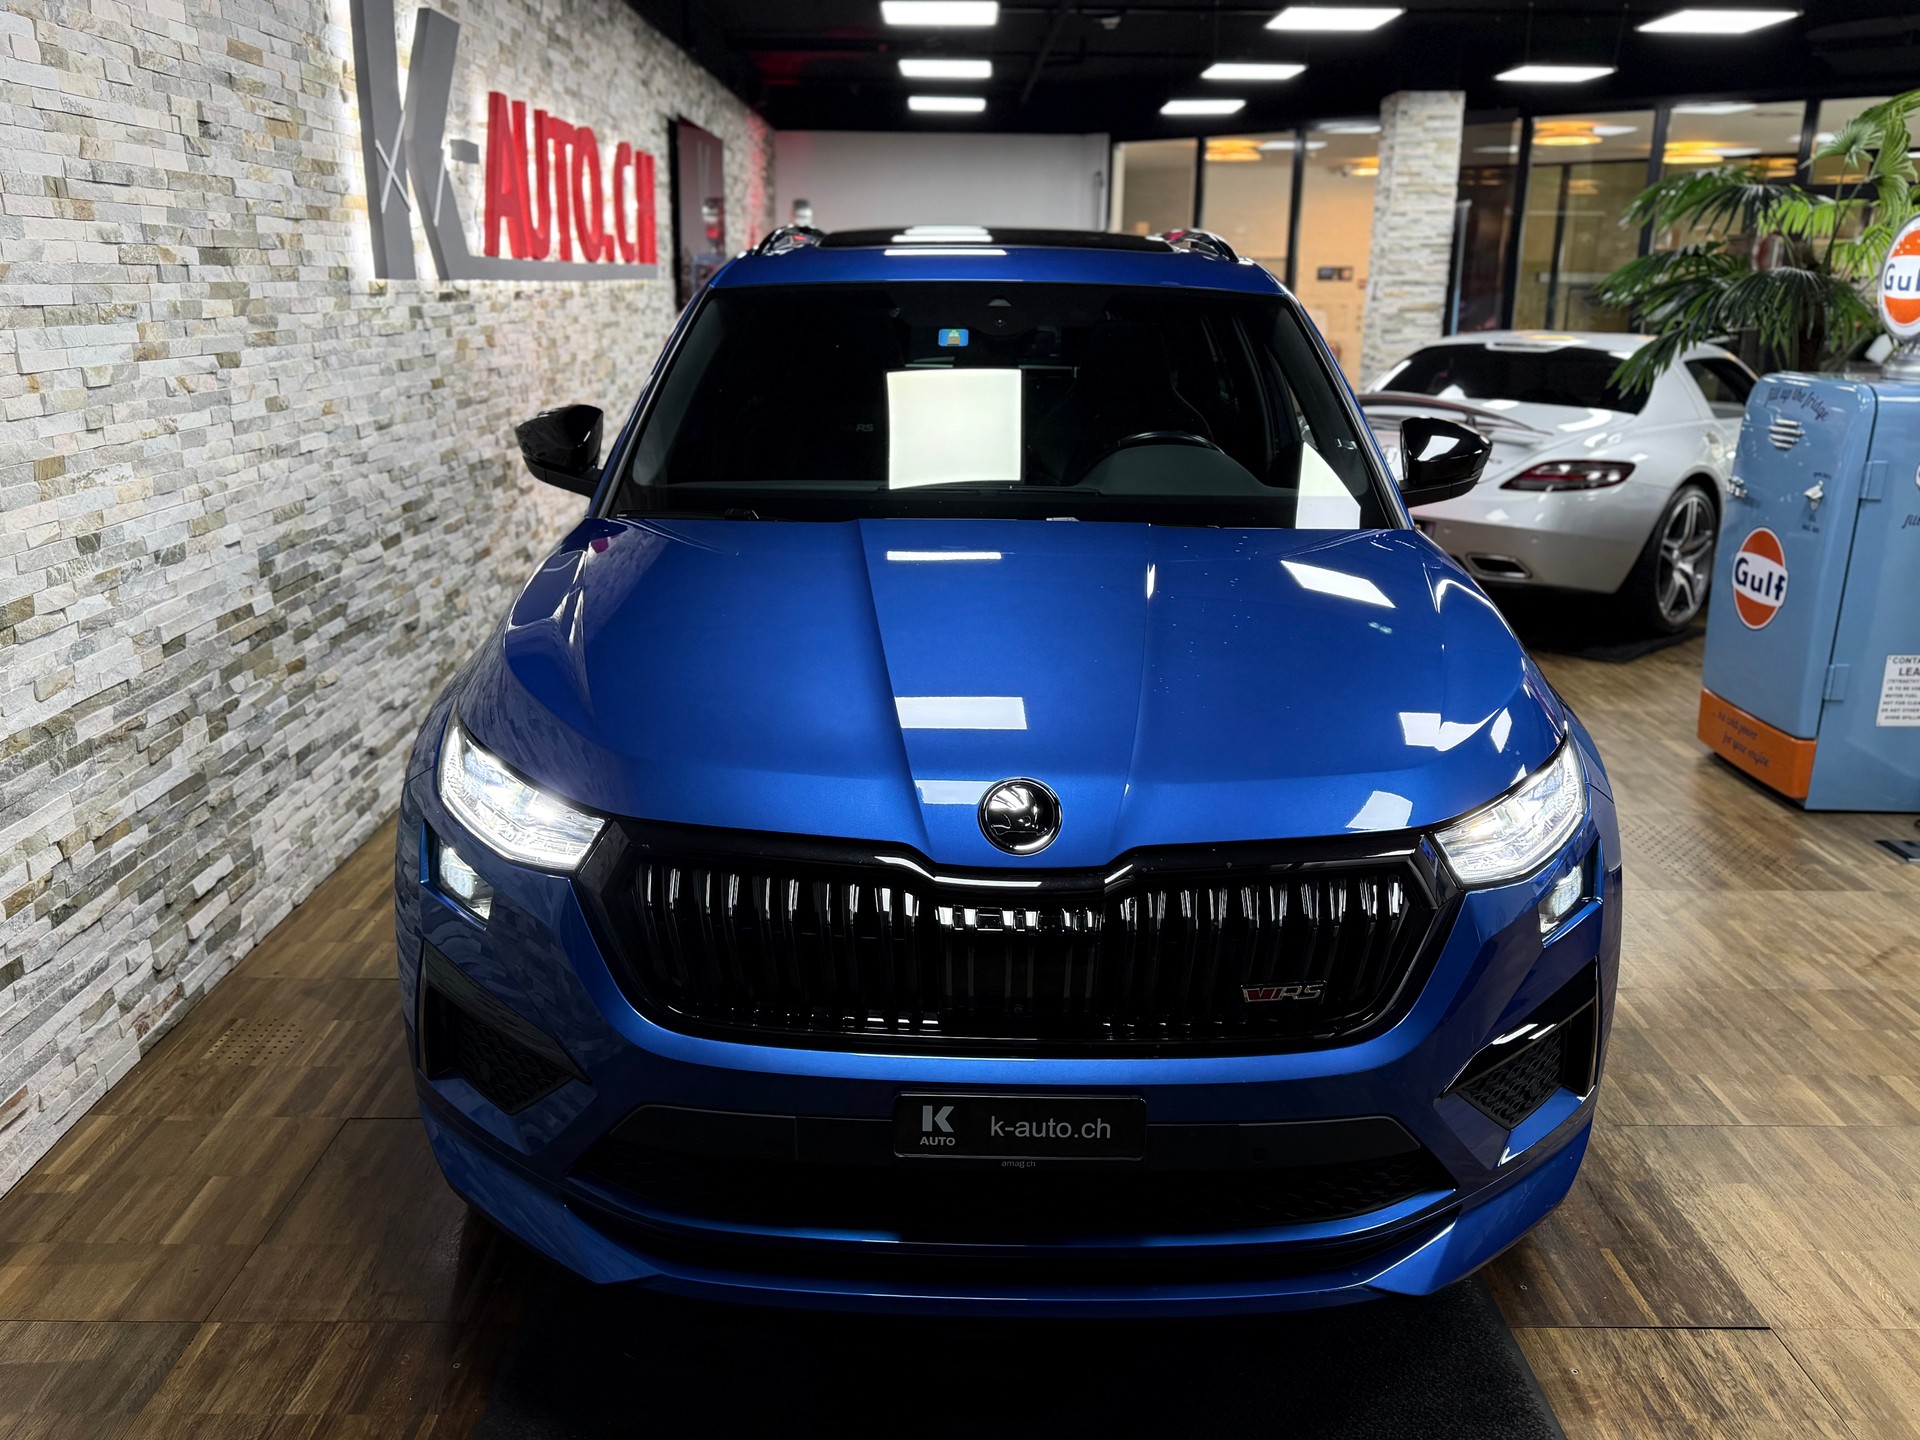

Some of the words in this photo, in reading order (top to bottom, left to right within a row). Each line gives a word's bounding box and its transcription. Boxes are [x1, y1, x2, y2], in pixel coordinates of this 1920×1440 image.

[1735, 558, 1786, 602] Gulf
[922, 1105, 955, 1133] K
[990, 1115, 1111, 1139] k-auto.ch
[919, 1136, 956, 1147] AUTO
[1001, 1159, 1036, 1168] amag.ch
